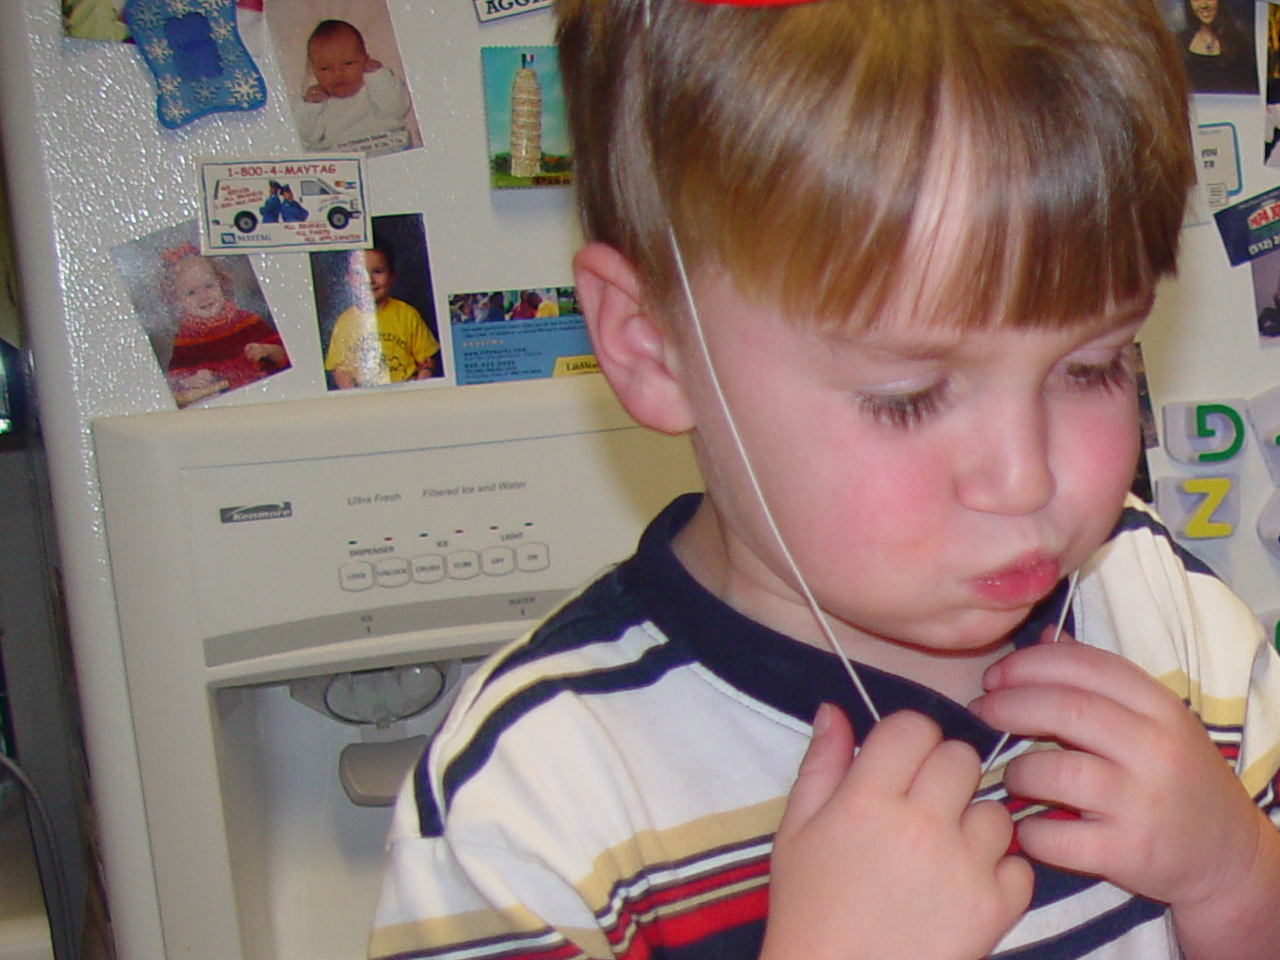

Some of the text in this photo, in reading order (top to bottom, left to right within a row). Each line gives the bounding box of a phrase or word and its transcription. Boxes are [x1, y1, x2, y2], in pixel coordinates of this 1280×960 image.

[227, 164, 337, 177] 1-800-4-MAYTAG
[236, 233, 272, 242] MAYTAG
[422, 481, 527, 498] Filtered Ice and Water
[347, 492, 402, 506] Ultra Fresh
[232, 507, 291, 522] Kenmore
[501, 532, 524, 542] LIGHT
[349, 546, 395, 557] DISPENSER
